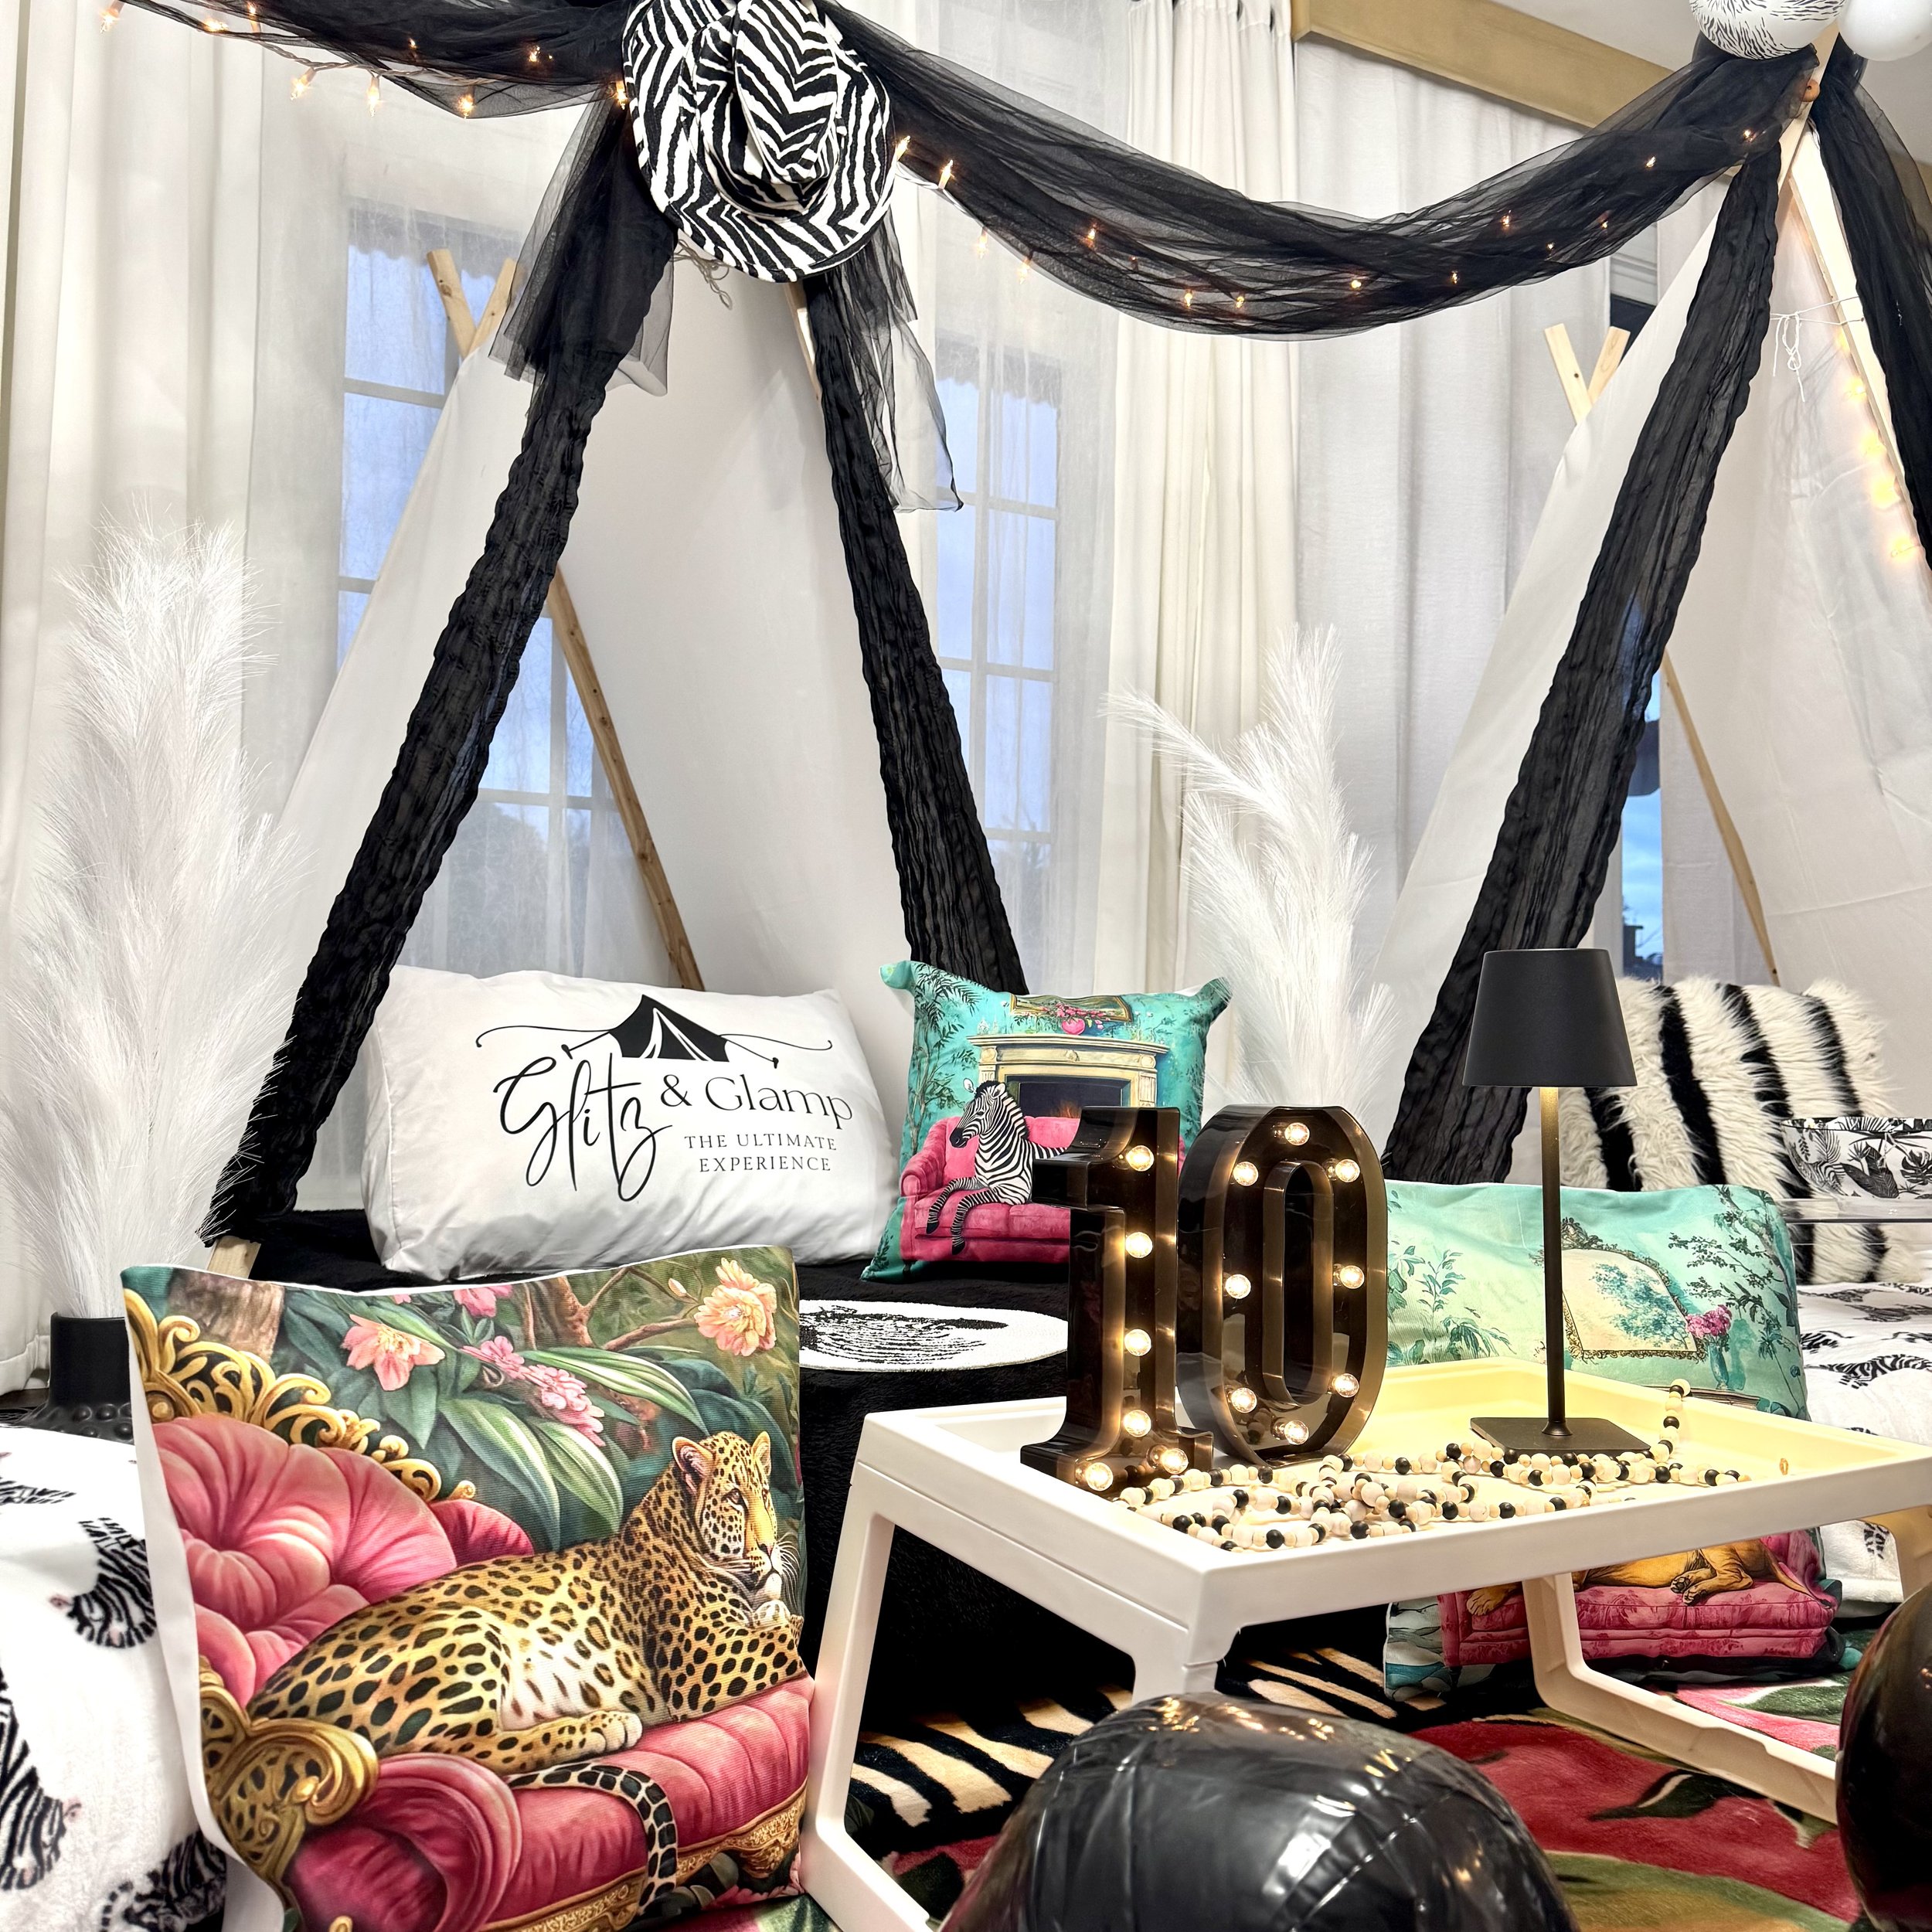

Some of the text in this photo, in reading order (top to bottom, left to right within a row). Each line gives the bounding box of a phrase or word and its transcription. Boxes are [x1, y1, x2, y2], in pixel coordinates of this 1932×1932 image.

[493, 1052, 853, 1202] Glitz & Glamp
[684, 1133, 837, 1151] THE ULTIMATE
[699, 1155, 832, 1173] EXPERIENCE
[1021, 1104, 1388, 1498] 10
